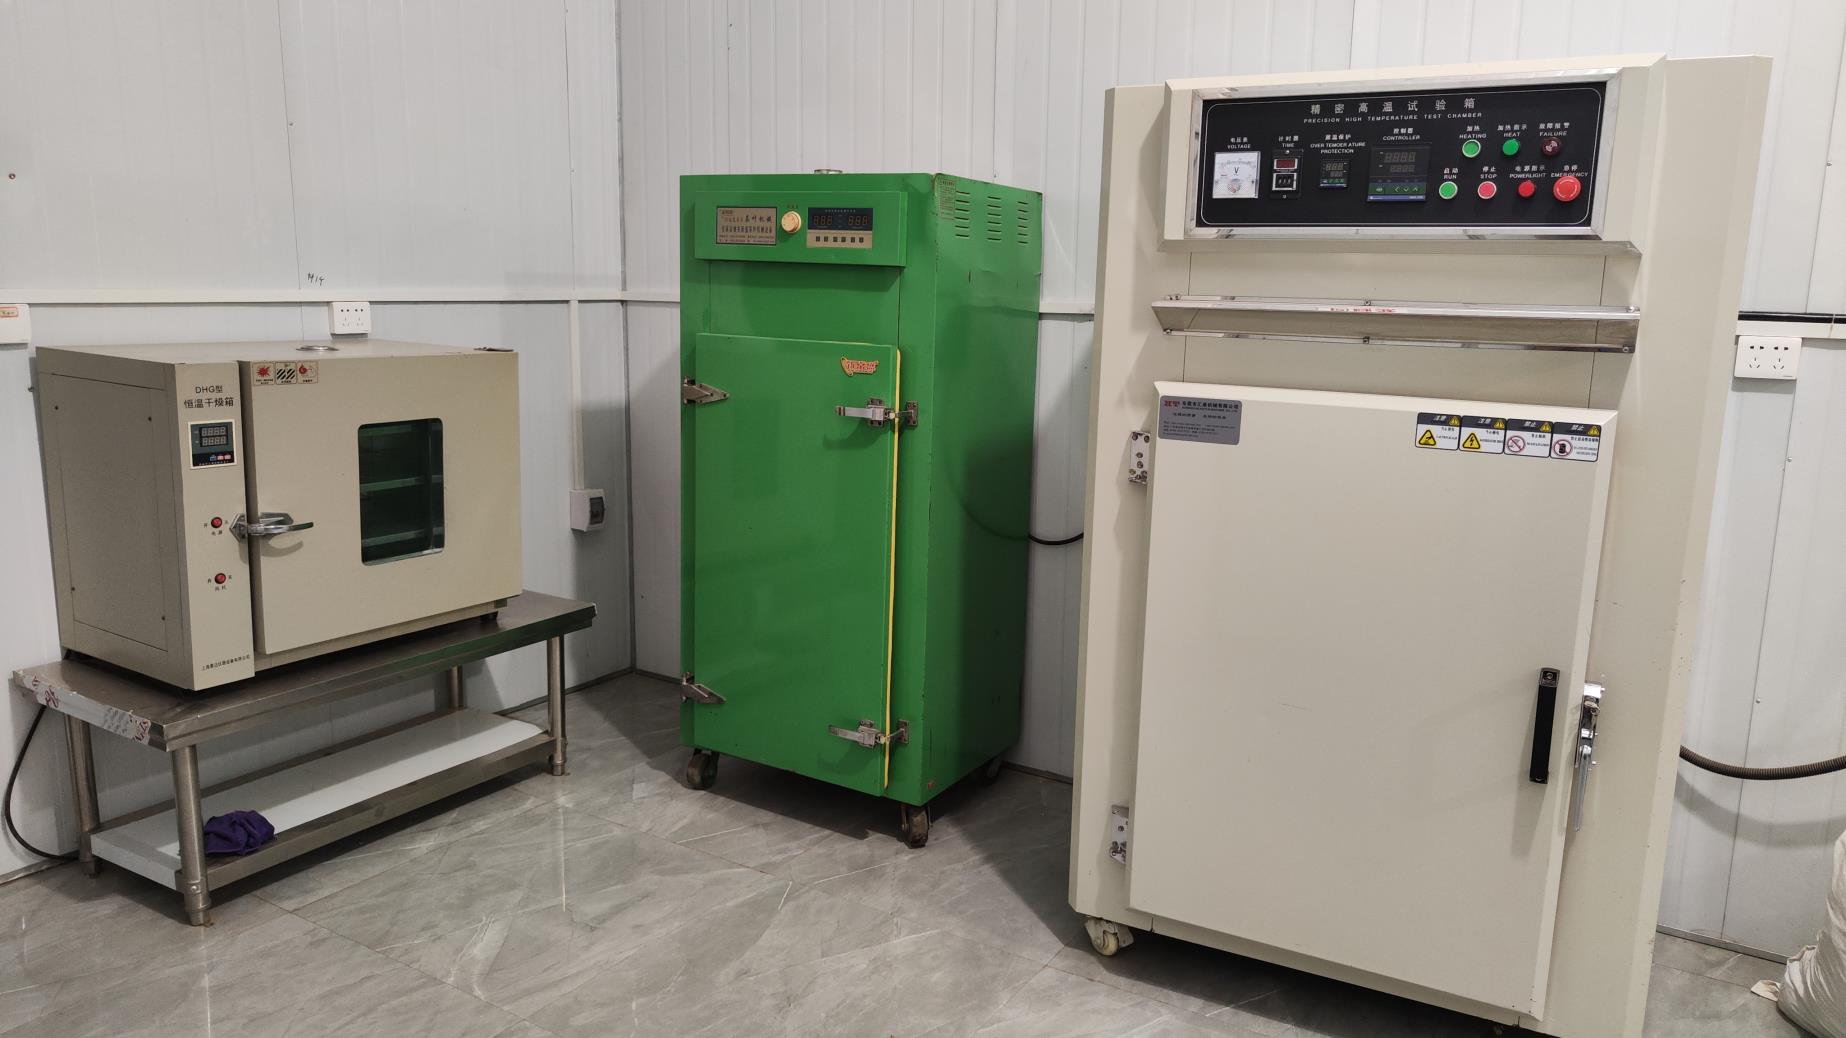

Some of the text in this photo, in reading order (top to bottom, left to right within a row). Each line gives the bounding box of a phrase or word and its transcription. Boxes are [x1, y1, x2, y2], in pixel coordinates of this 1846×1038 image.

[1310, 97, 1476, 116] 精密高温试验箱
[1367, 114, 1419, 122] TEMPERATURE
[1234, 166, 1240, 174] V
[195, 385, 223, 394] DHG型
[183, 397, 234, 409] 恒温干燥箱
